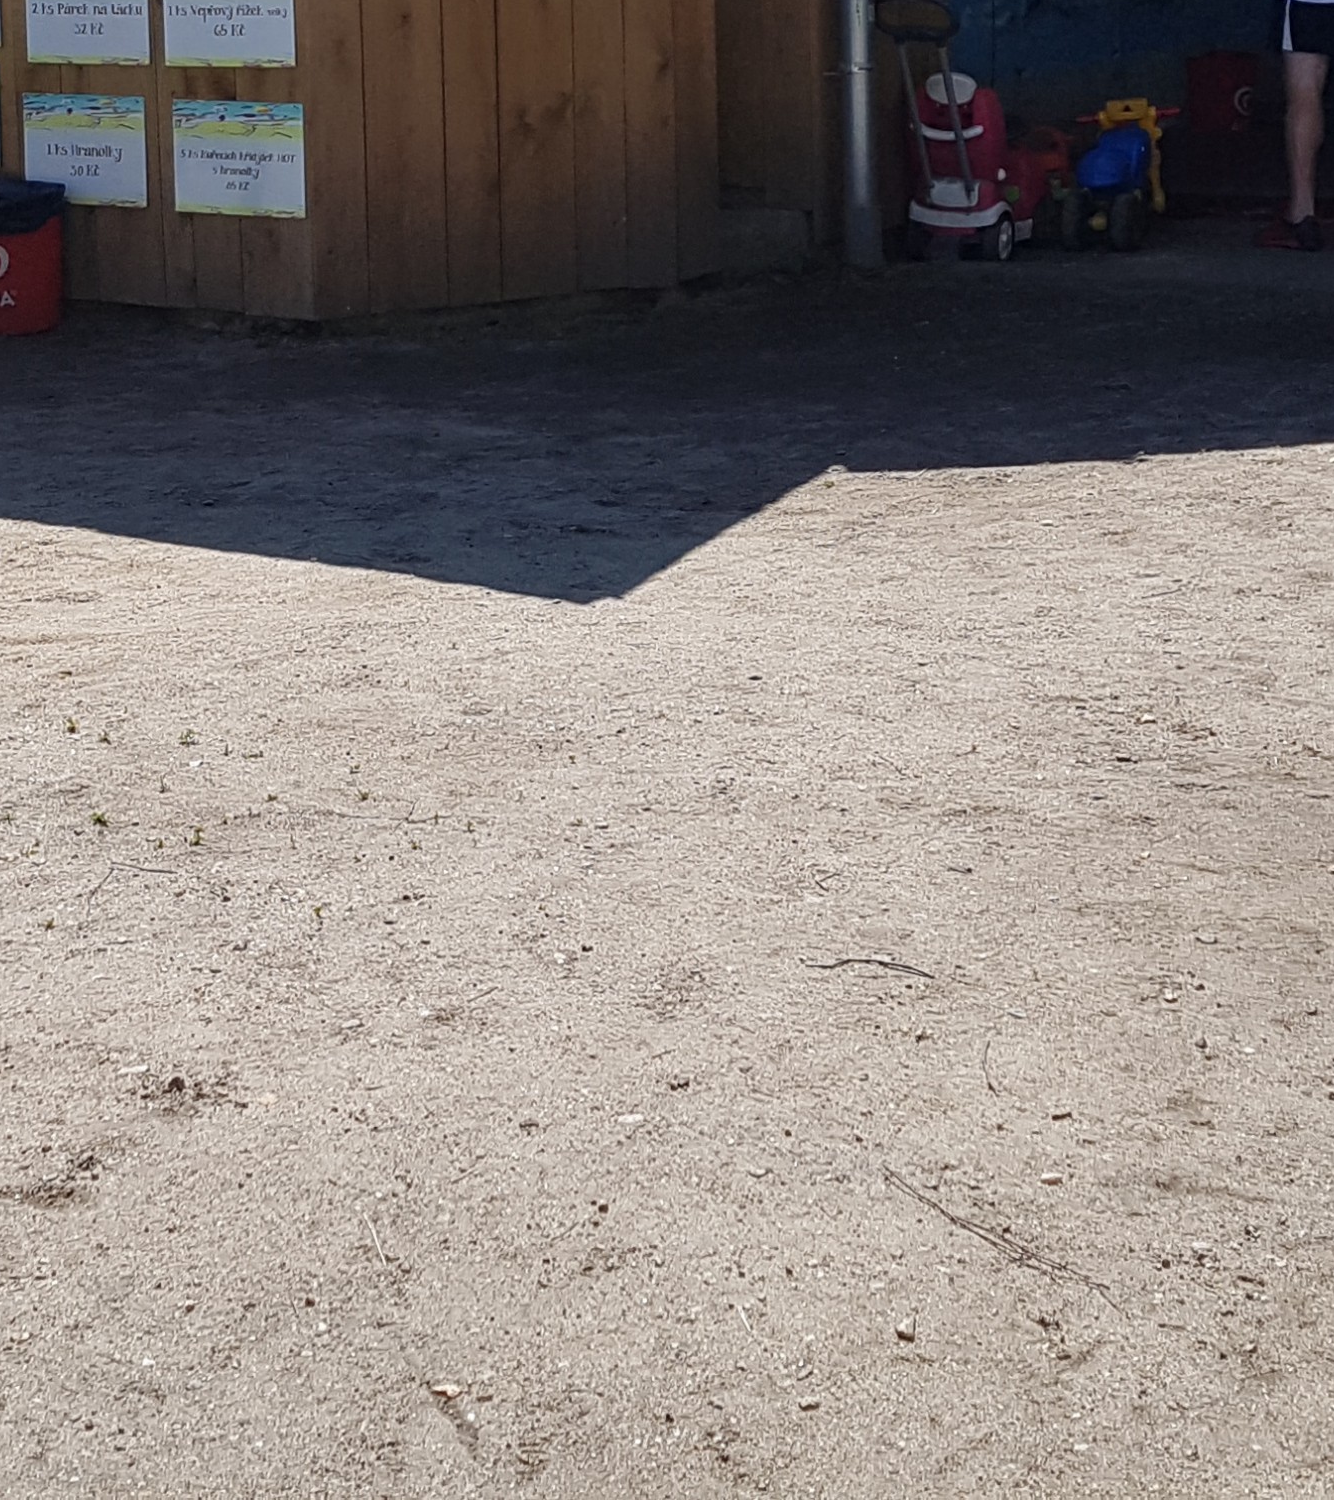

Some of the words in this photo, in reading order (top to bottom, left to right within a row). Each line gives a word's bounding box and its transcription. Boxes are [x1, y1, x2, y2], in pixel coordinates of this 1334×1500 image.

[31, 3, 38, 15] 2
[42, 2, 54, 16] ks
[57, 2, 88, 16] Párek
[93, 4, 108, 16] na
[175, 5, 188, 17] ks
[90, 22, 105, 36] Kč
[213, 24, 228, 37] 65
[230, 22, 246, 37] Kč
[54, 143, 69, 156] ks
[71, 143, 124, 163] Hranolky
[86, 163, 101, 177] Kč
